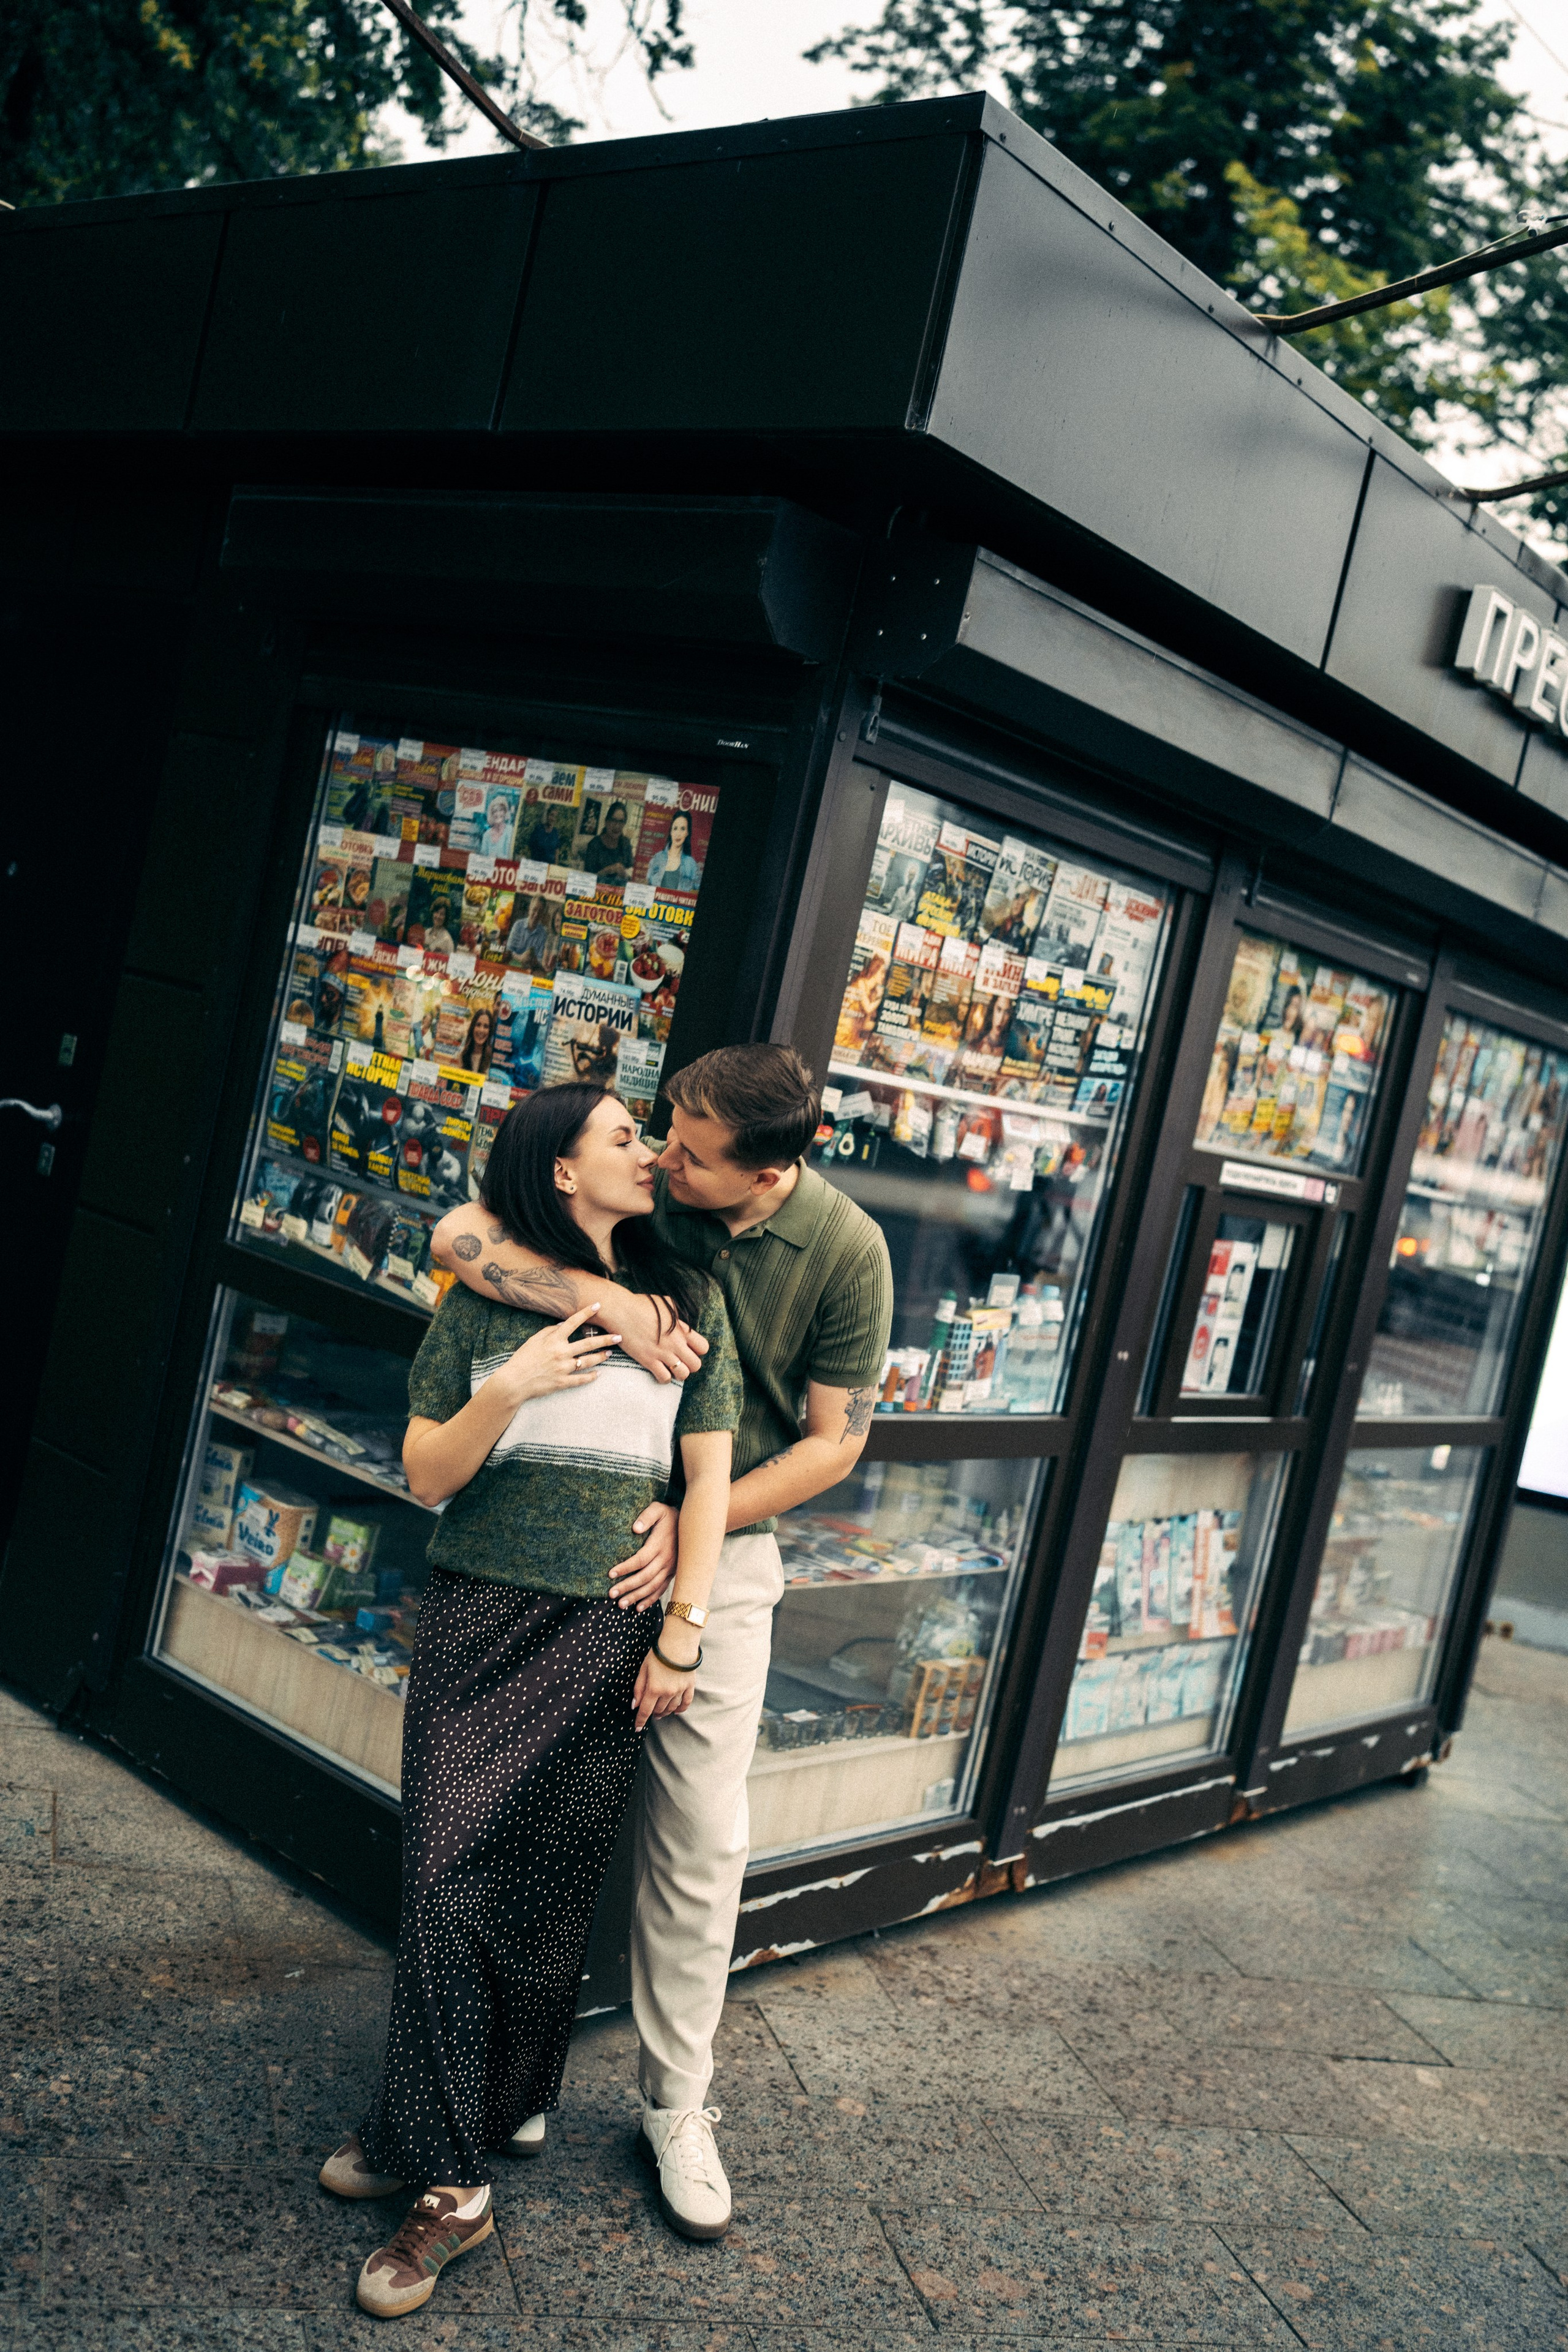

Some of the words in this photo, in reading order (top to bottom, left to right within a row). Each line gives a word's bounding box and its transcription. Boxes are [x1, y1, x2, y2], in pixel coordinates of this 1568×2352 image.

[1455, 584, 1568, 739] ПРЕ
[542, 785, 574, 803] сами
[552, 995, 633, 1031] ИСТОРИИ
[581, 988, 635, 1010] ДУМАННЫЕ
[346, 1061, 401, 1090] ИСТОРИЯ
